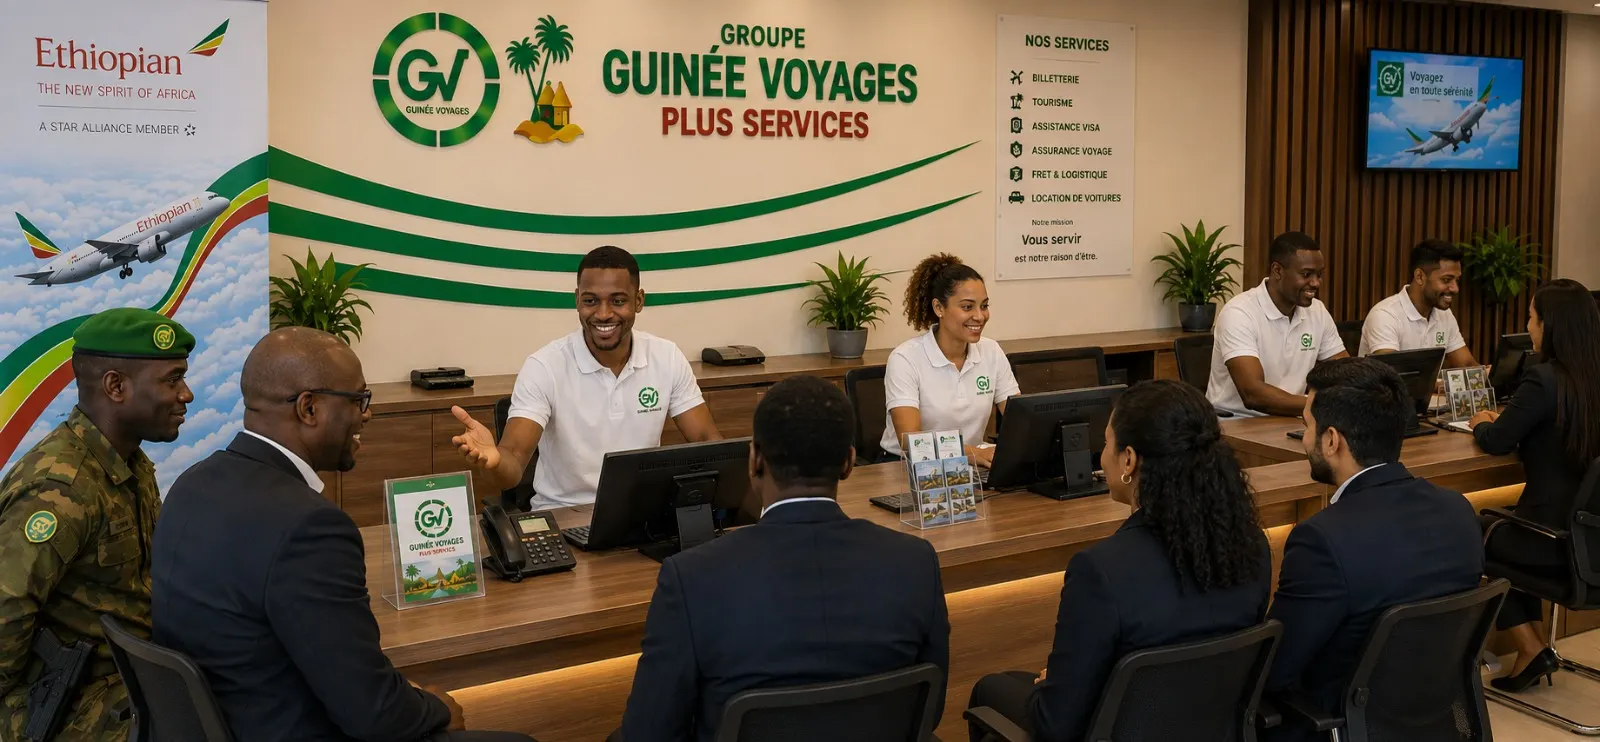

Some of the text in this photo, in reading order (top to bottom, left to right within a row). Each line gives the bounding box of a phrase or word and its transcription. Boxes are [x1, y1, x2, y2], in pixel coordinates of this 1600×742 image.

[720, 23, 806, 49] GROUPE
[1025, 34, 1109, 51] NOS SERVICES
[35, 37, 182, 80] Ethiopian
[397, 48, 469, 102] GV
[602, 45, 918, 104] GUINÉE VOYAGES
[1032, 73, 1080, 84] BILLETTERIE
[1383, 72, 1397, 85] GV
[1410, 71, 1444, 84] Voyagez
[37, 82, 196, 100] THE NEW SPIRIT OF AFRICA
[1409, 86, 1474, 97] en toute sérénité
[1032, 98, 1073, 107] TOURISME
[405, 104, 470, 116] GUINÉE VOYAGES
[39, 121, 179, 135] A STAR ALLIANCE MEMBER
[662, 107, 869, 139] PLUS SERVICES
[1032, 122, 1101, 132] ASSISTANCE VISA
[1032, 146, 1113, 156] ASSURANCE VOYAGE
[1032, 170, 1107, 180] FRET & LOGISTIQUE
[1032, 193, 1121, 203] LOCATION DE VOITURES
[137, 202, 192, 233] Ethiopian
[1050, 218, 1074, 226] mission
[1022, 232, 1081, 246] Vous servir
[1014, 254, 1027, 263] est
[1028, 254, 1049, 262] notre
[1050, 253, 1073, 262] raison
[421, 507, 445, 528] GV
[409, 537, 464, 551] GUINÉE VOYAGES
